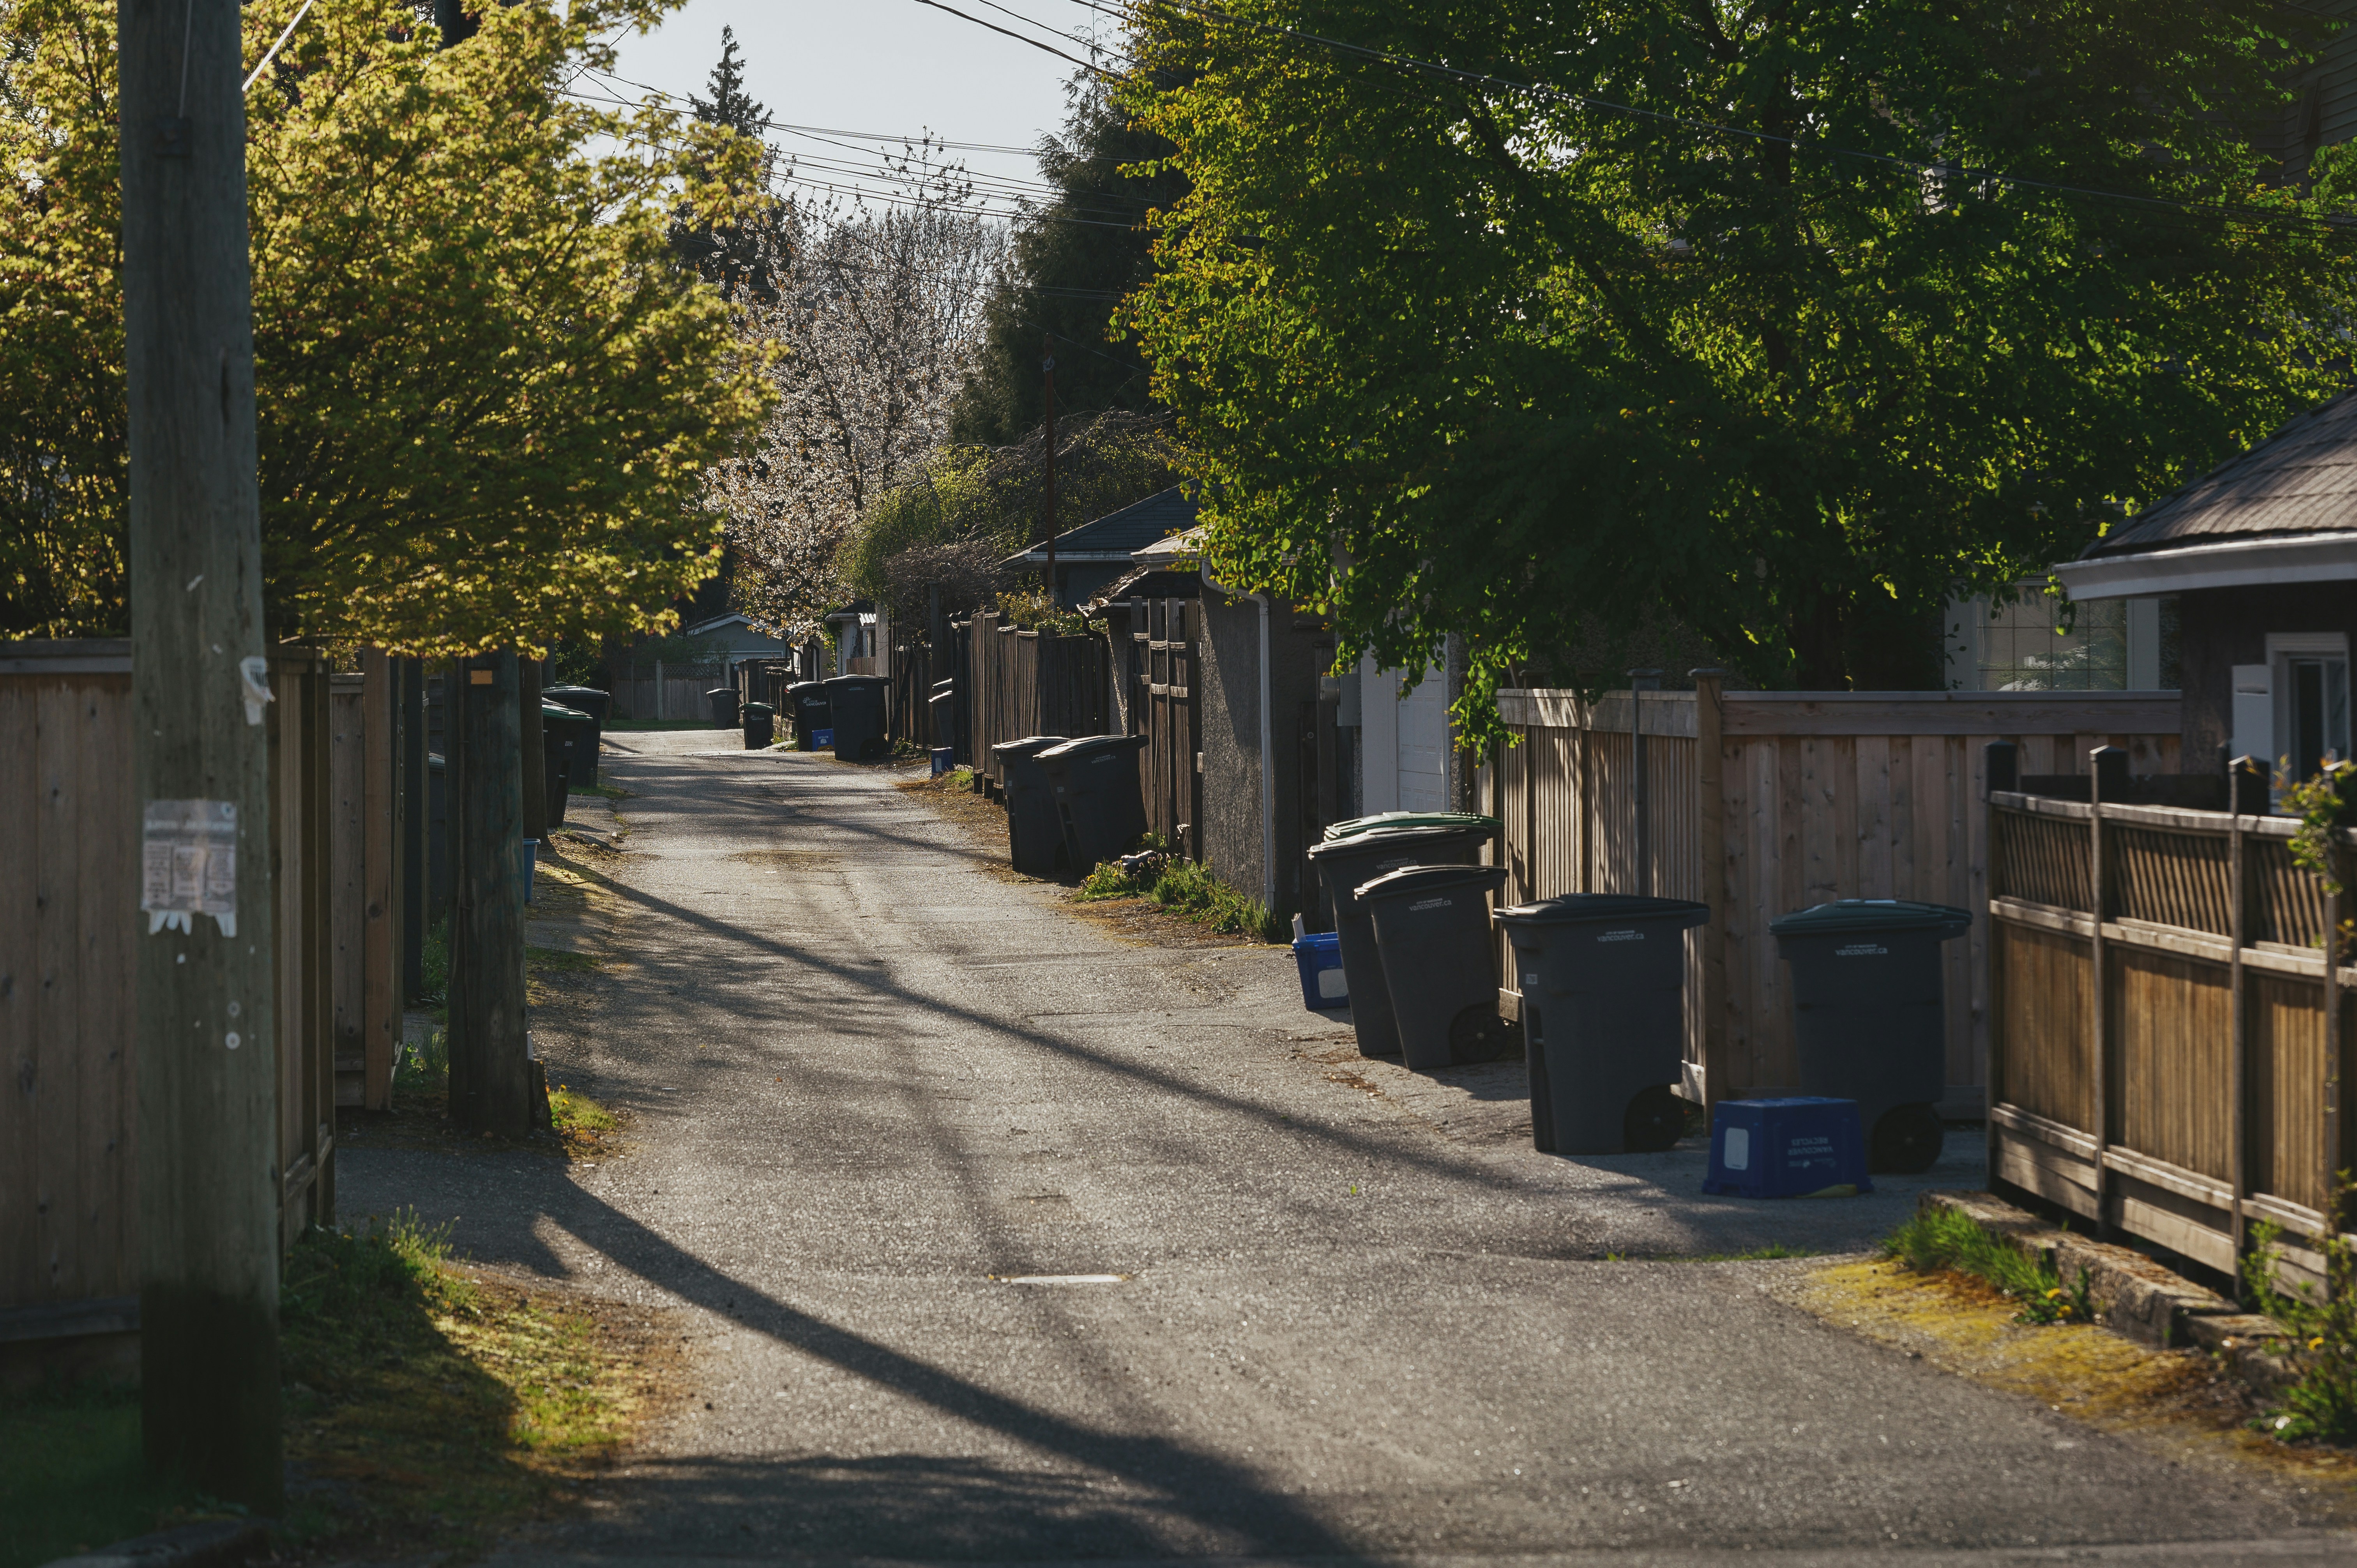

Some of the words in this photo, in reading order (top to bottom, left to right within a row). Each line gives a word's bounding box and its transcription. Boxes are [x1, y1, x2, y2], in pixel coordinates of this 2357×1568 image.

[1091, 756, 1116, 764] vancouver.ca
[1376, 860, 1417, 870] vancouver.ca
[1409, 900, 1452, 911] vancouver.ca
[1596, 933, 1644, 942] vancouver.ca
